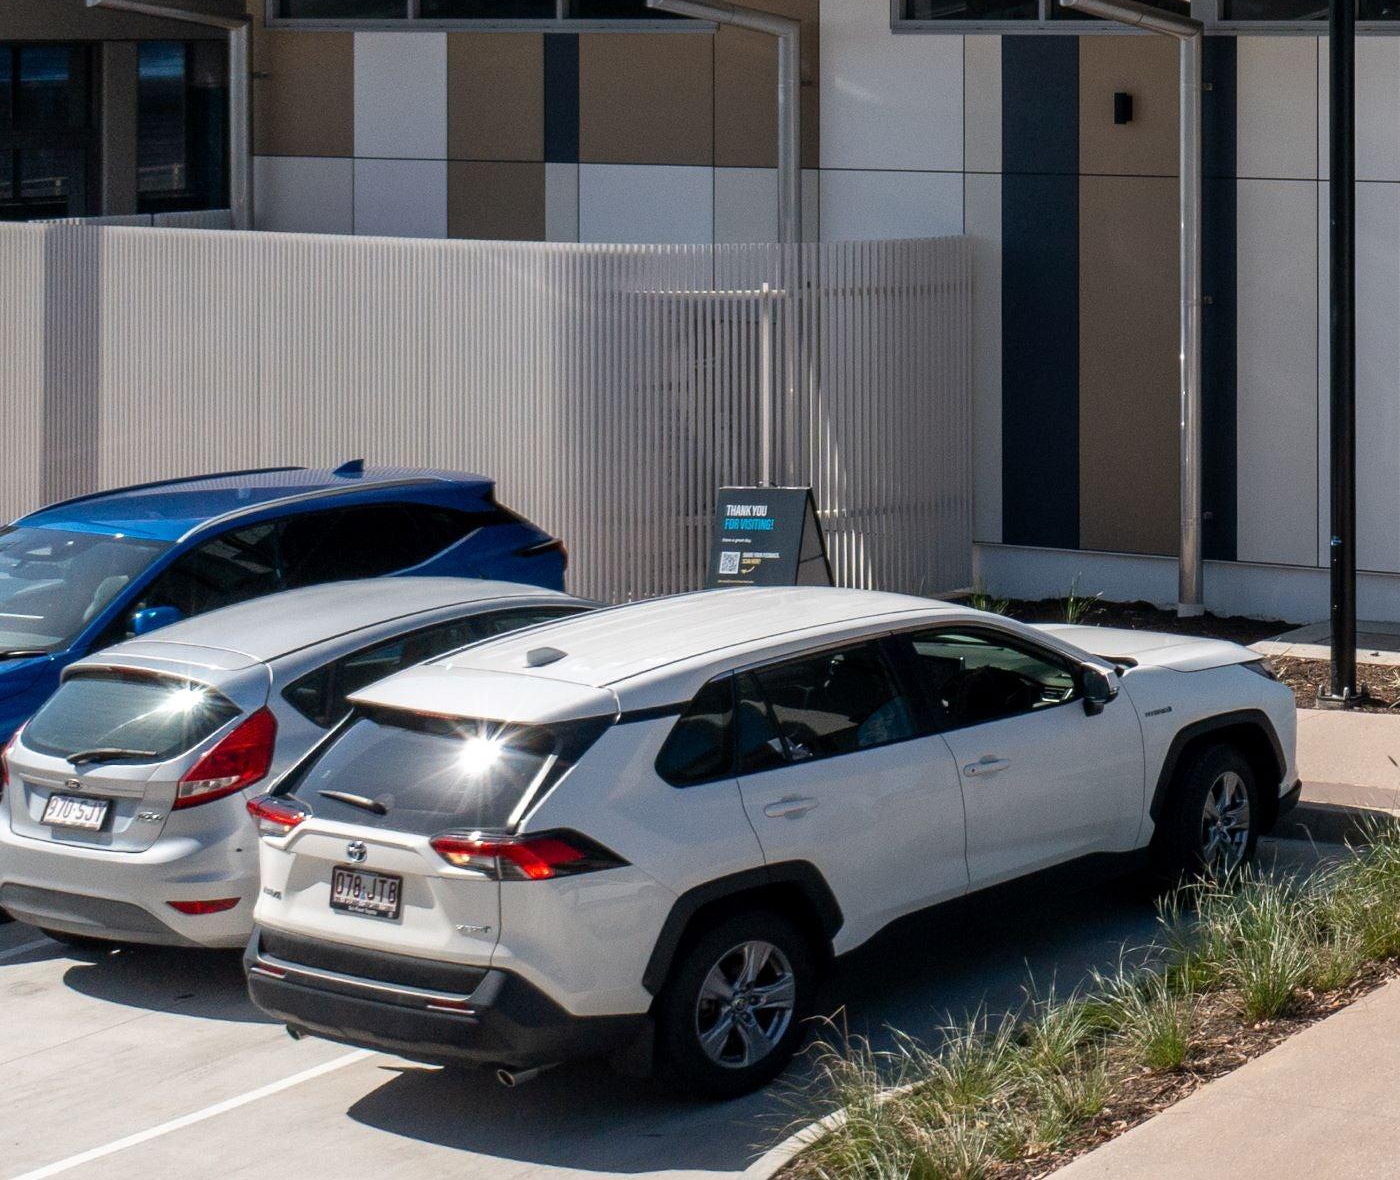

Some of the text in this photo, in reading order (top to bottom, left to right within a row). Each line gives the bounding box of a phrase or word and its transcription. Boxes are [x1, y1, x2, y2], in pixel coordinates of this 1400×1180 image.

[726, 504, 768, 517] THANK YOU
[724, 518, 774, 531] FOR VISITING!
